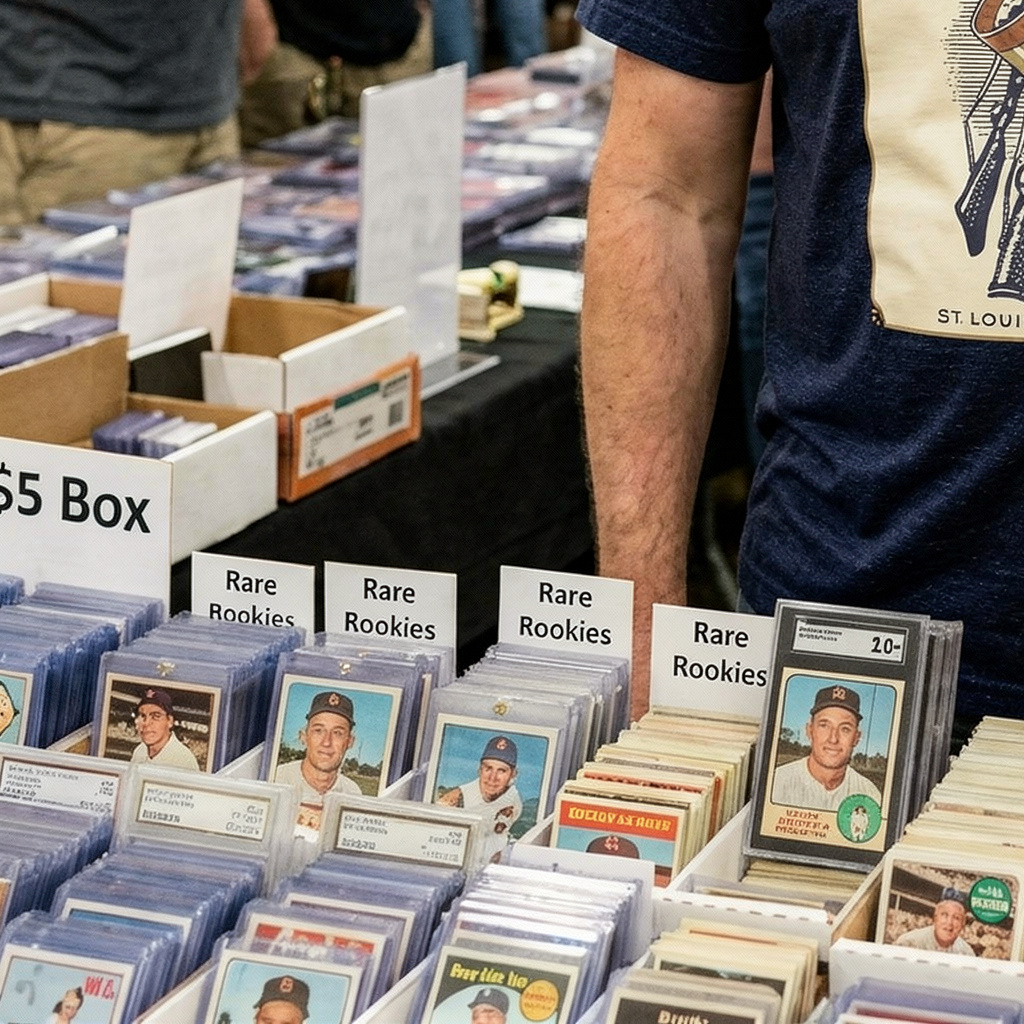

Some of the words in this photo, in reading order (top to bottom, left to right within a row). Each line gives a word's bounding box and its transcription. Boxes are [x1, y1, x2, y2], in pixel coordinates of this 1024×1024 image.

[937, 308, 964, 324] ST.
[61, 475, 151, 534] Box
[226, 569, 277, 596] Rare
[363, 577, 415, 604] Rare
[539, 581, 593, 608] Rare
[209, 602, 294, 627] Rookies
[345, 611, 437, 641] Rookies
[519, 615, 612, 646] Rookies
[694, 621, 749, 648] Rare
[673, 655, 767, 687] Rookies
